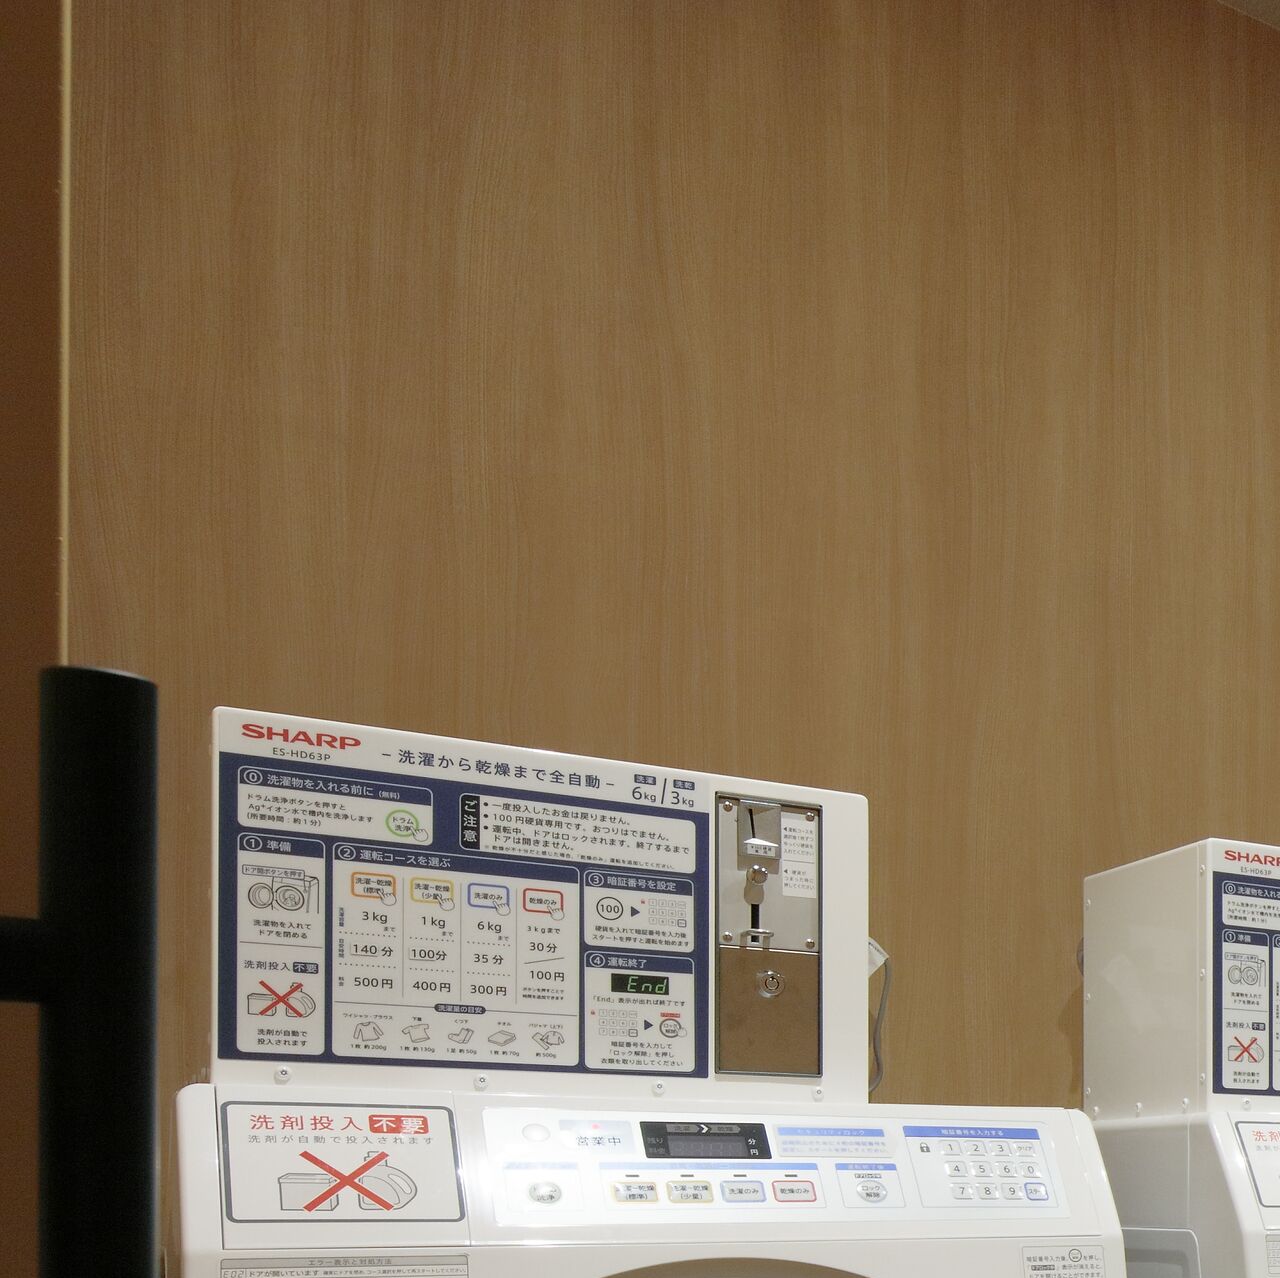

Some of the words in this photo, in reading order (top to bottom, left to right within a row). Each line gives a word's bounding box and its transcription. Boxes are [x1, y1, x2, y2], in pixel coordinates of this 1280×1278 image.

[241, 723, 361, 749] SHARP
[272, 747, 331, 761] ES-HD63P
[463, 800, 478, 842] ご注意
[267, 840, 291, 852] 準備
[360, 849, 450, 868] 運転コースを選ぶ
[607, 876, 676, 891] 暗証番号を設定
[600, 905, 619, 913] 100
[244, 960, 290, 971] 洗剤投入
[608, 957, 647, 968] 運転終了
[627, 976, 667, 993] End
[249, 1114, 362, 1131] 洗剤投入
[373, 1116, 425, 1134] 不要
[248, 1134, 434, 1145] 洗剤が自動で投入されます
[576, 1136, 621, 1146] 営業中
